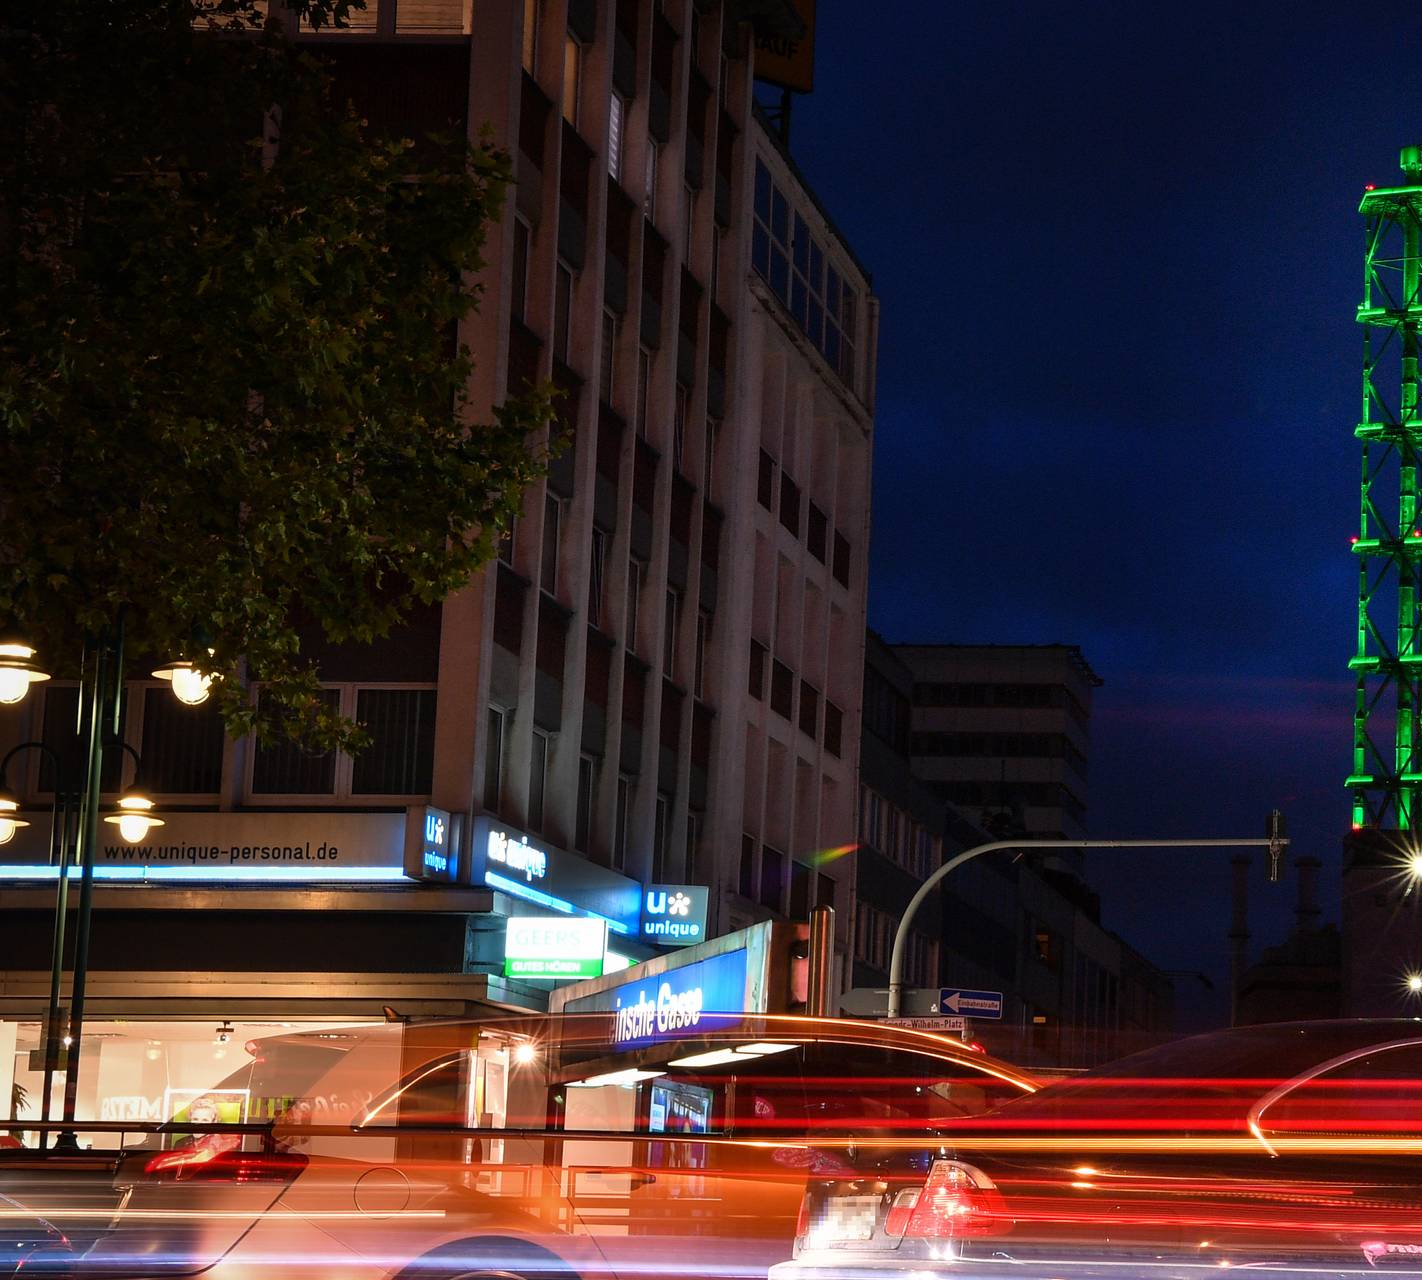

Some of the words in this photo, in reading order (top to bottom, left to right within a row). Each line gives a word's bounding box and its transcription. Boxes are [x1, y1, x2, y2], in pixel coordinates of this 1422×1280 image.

[104, 842, 338, 864] www.unique-personal.de
[514, 928, 583, 946] GEERS
[645, 920, 700, 938] unique
[658, 983, 703, 1032] Gasse
